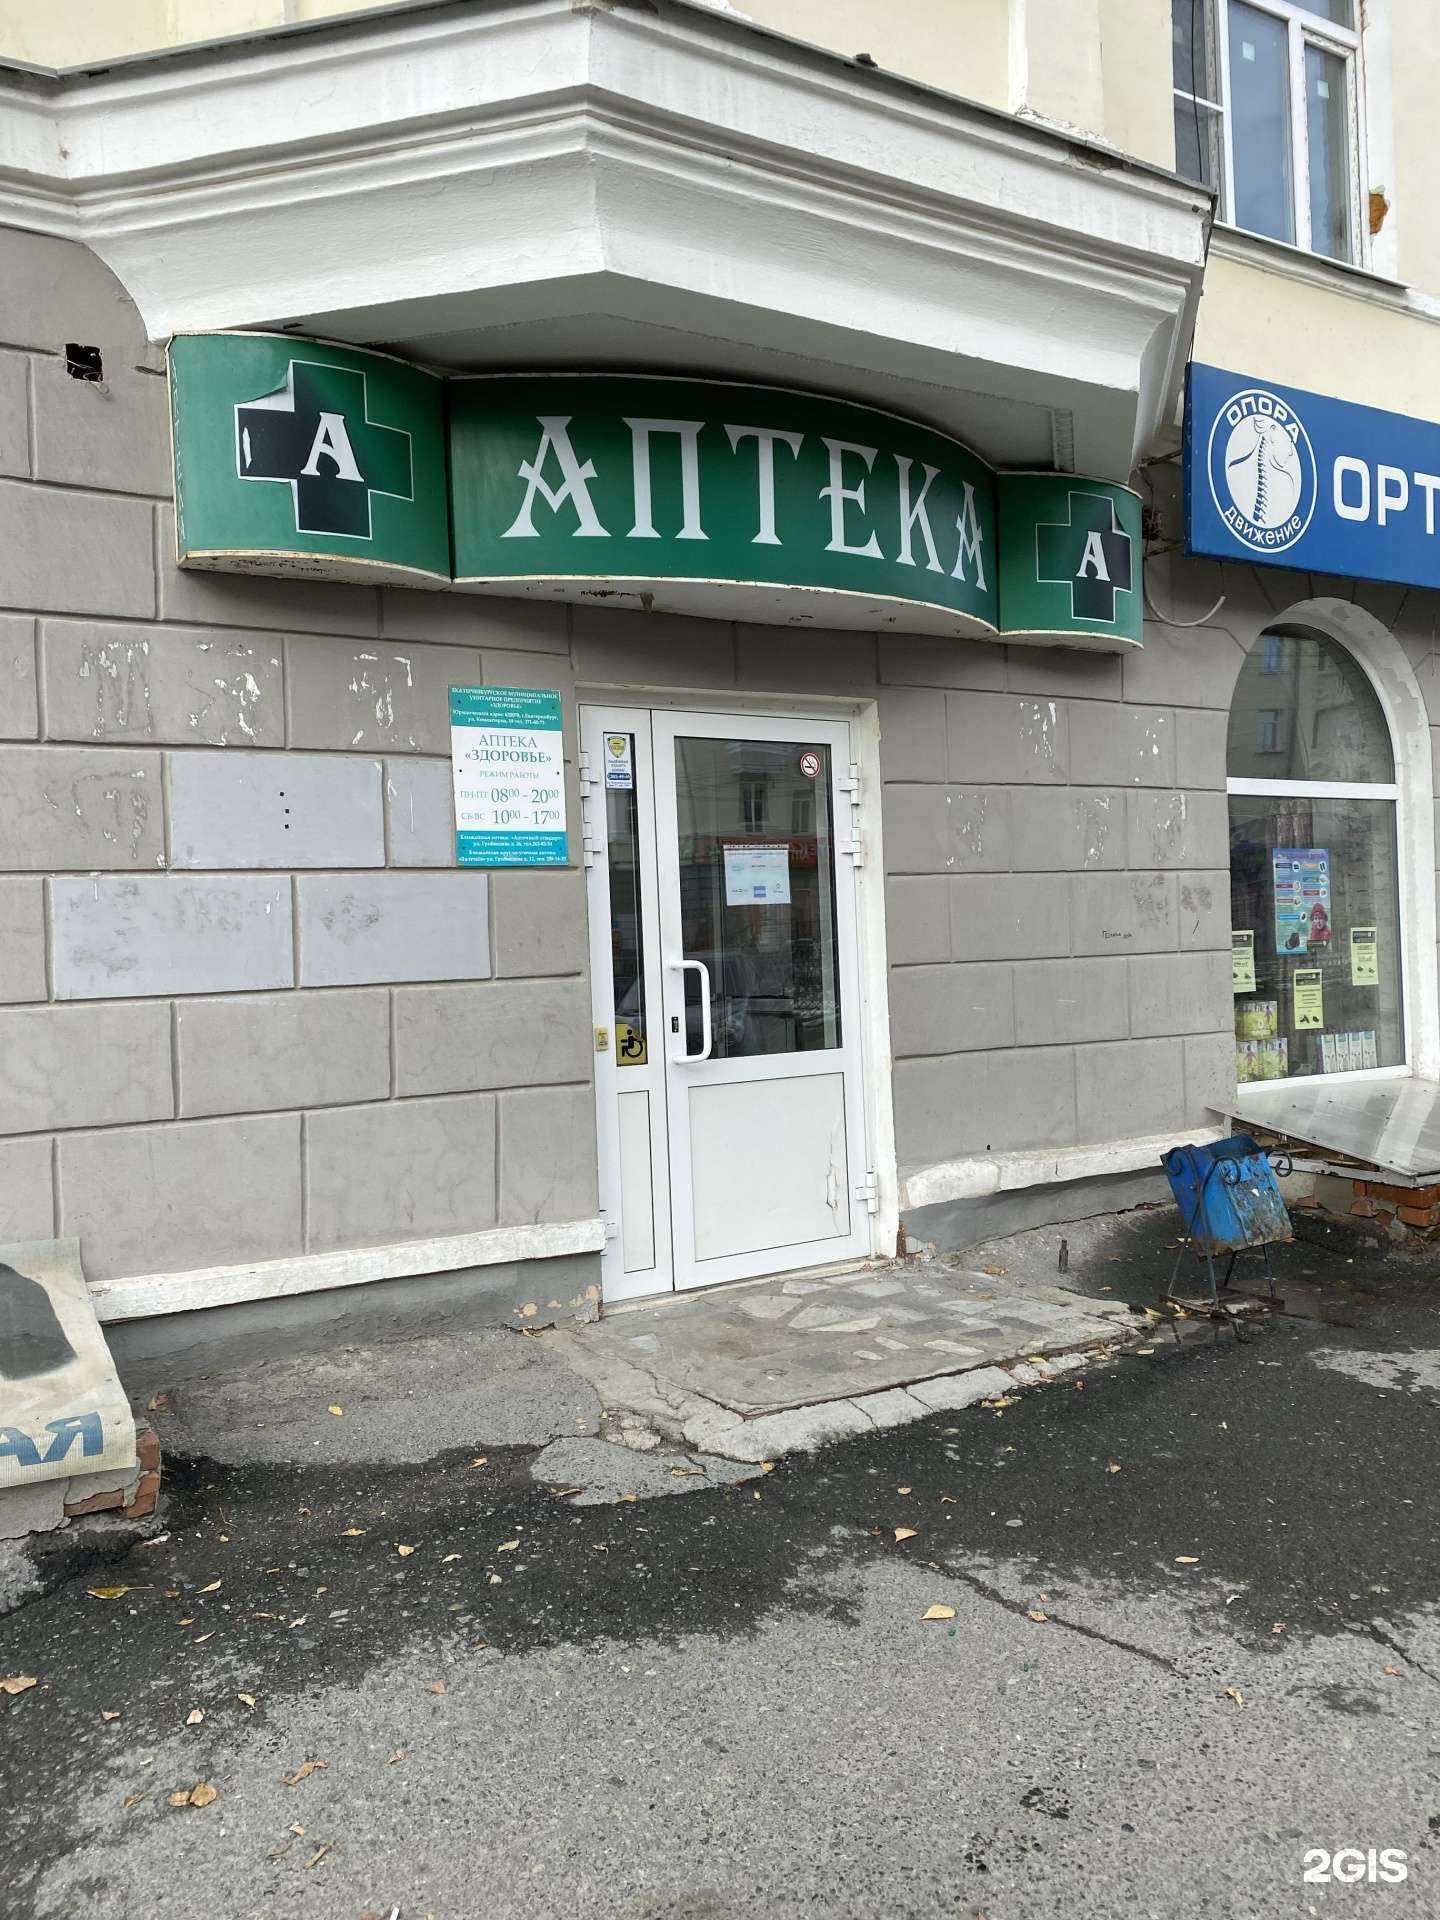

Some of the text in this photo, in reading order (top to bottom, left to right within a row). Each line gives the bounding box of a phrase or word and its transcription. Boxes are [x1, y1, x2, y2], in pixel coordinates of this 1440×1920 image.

[1226, 396, 1301, 444] ОПОРА
[300, 411, 365, 482] А
[500, 415, 987, 593] АПТЕКА
[1333, 455, 1440, 535] ОРТ
[1075, 530, 1111, 582] А
[465, 749, 552, 763] «ЗДОРОВЬЕ»
[479, 734, 537, 748] АПТЕКА
[480, 770, 540, 779] РЕЖИМ РАБОТЫ
